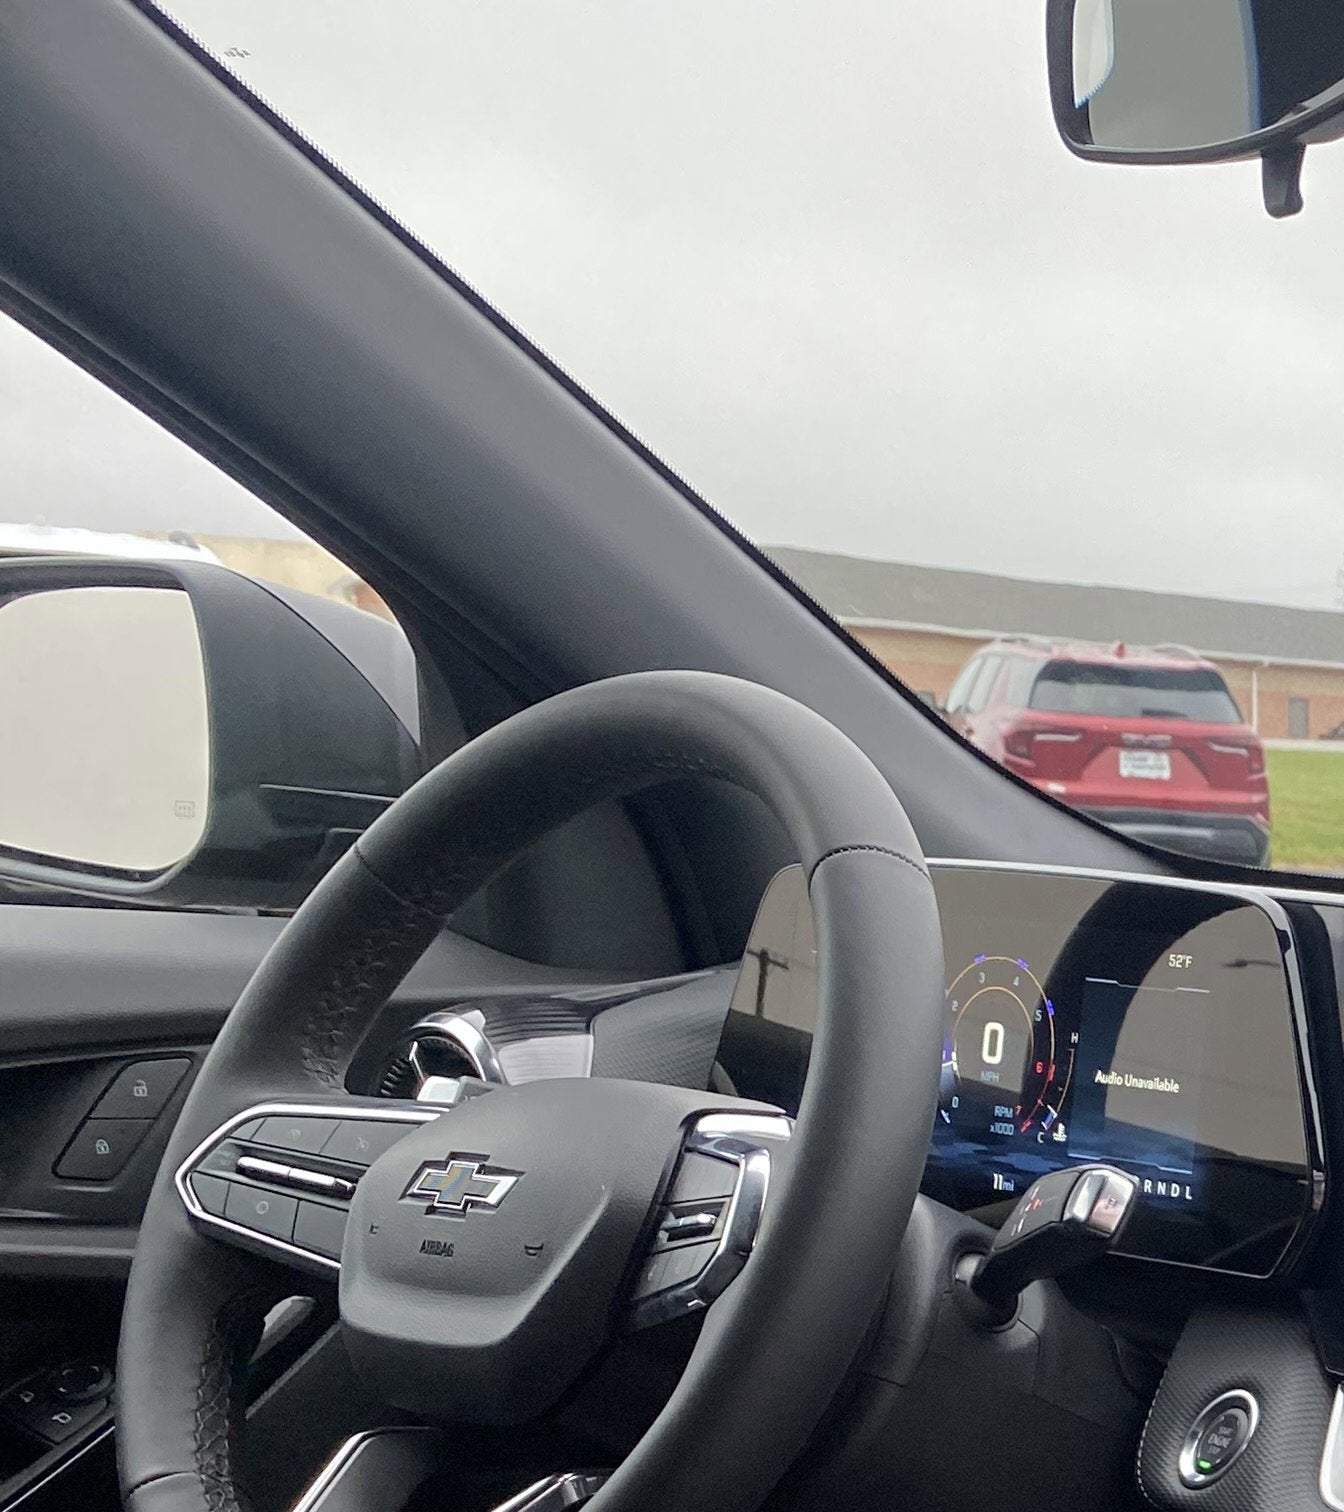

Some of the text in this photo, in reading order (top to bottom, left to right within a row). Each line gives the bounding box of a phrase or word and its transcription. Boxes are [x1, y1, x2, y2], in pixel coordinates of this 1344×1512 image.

[1168, 954, 1192, 969] 52°F
[982, 1022, 1004, 1064] 0
[1071, 1032, 1079, 1044] H
[1036, 1062, 1043, 1074] 6
[981, 1071, 1000, 1083] MPH
[1095, 1069, 1179, 1094] Audio Unavailable
[952, 1097, 959, 1108] 0
[994, 1105, 1013, 1118] RPM
[989, 1123, 1014, 1136] x1000
[1037, 1132, 1044, 1144] C
[1144, 1181, 1192, 1199] R N D L
[419, 1239, 455, 1259] AIRBAG
